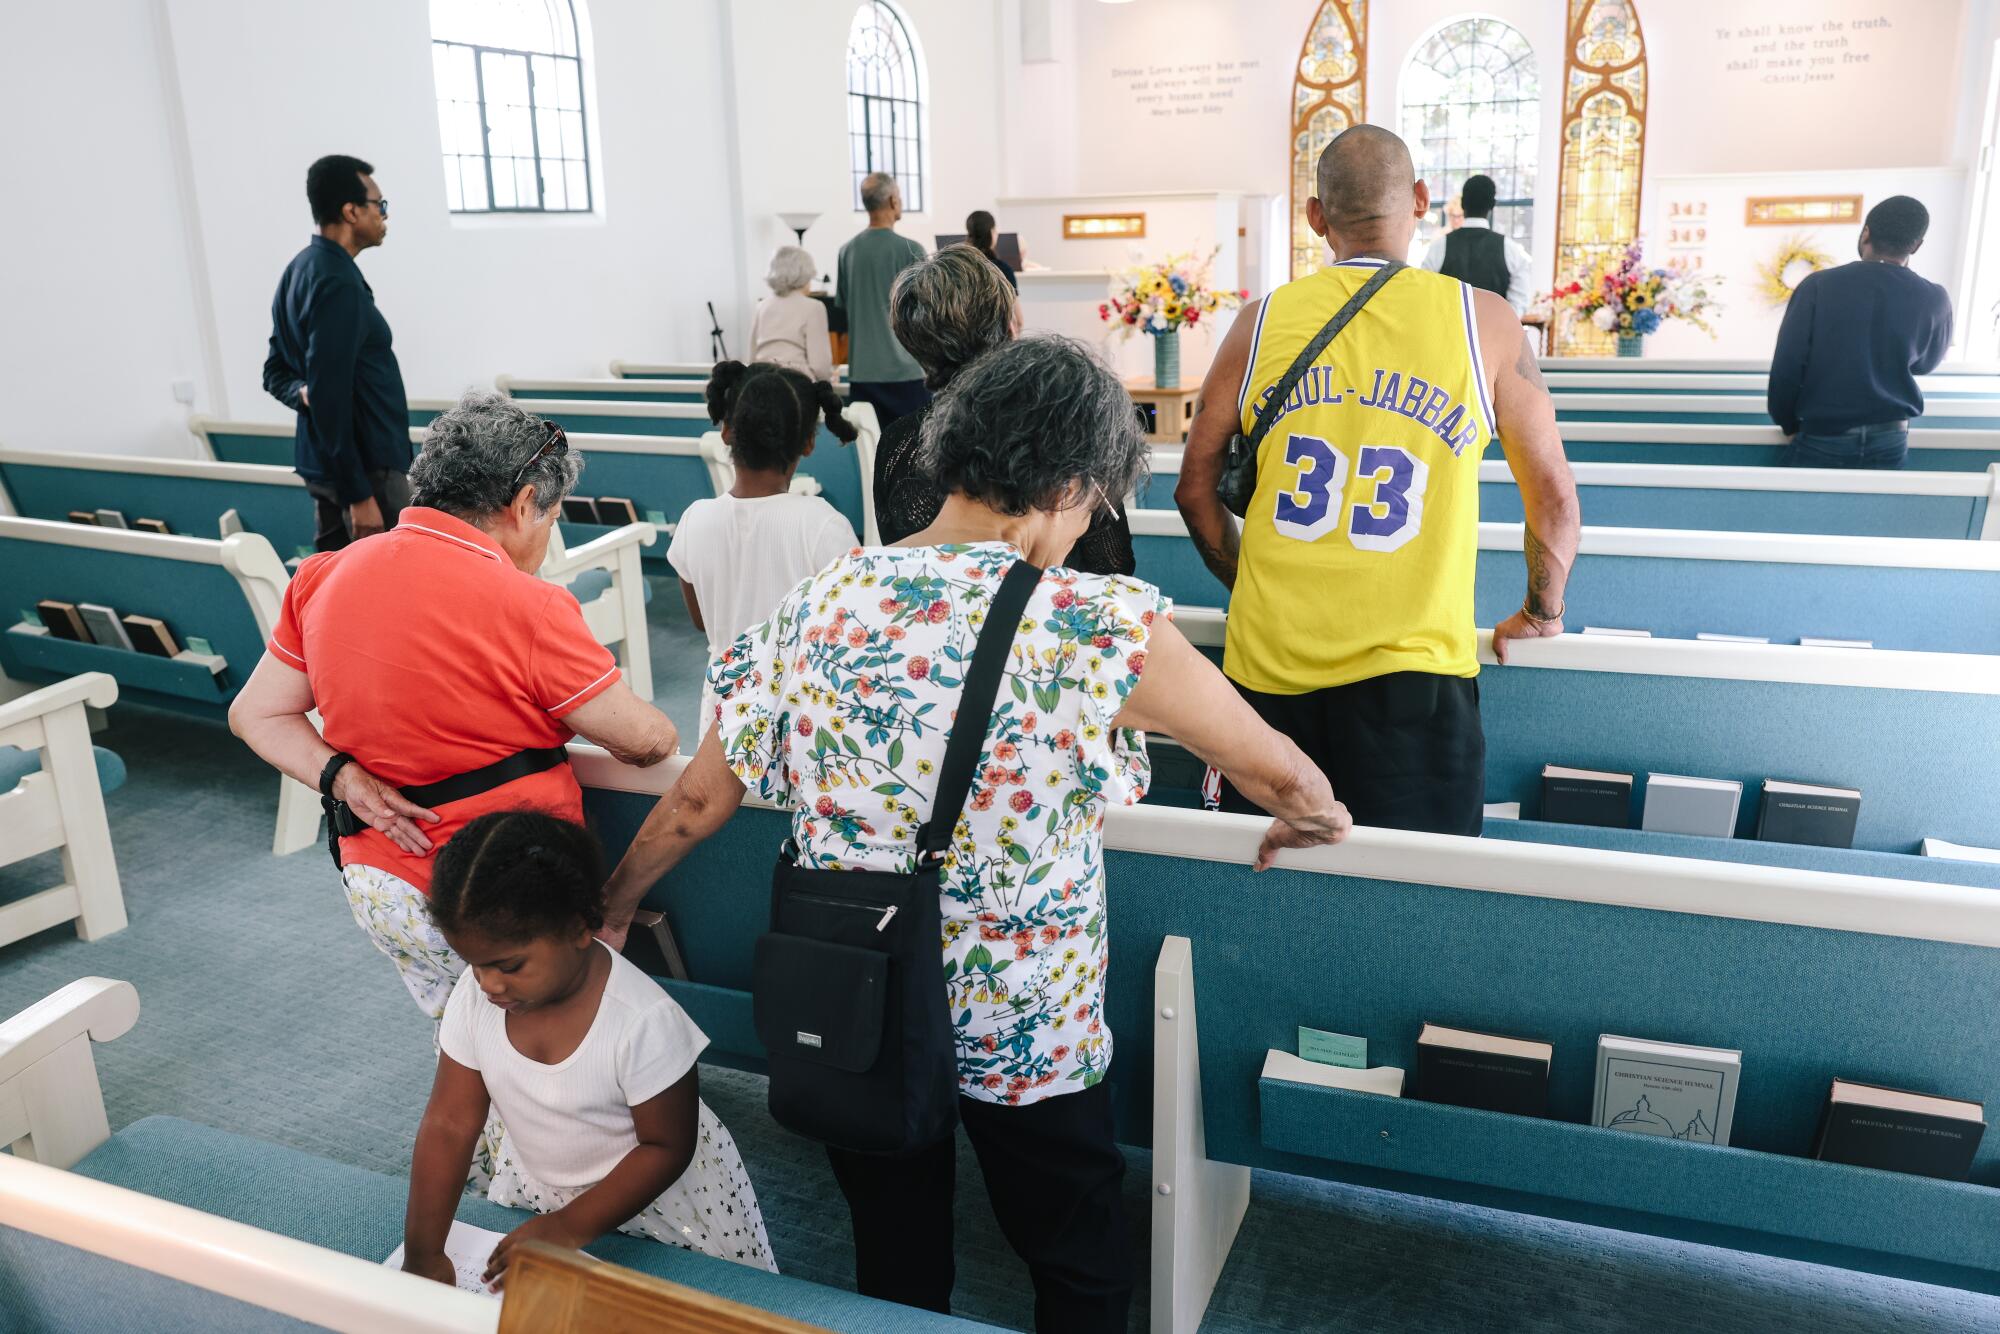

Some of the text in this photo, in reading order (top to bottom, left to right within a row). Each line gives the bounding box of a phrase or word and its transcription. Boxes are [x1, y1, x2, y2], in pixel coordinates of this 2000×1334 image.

[1716, 28, 1731, 40] Ye
[1738, 26, 1771, 38] shall
[1779, 24, 1814, 35] know
[1822, 20, 1844, 32] the
[1753, 37, 1848, 54] and the truth
[1727, 52, 1870, 72] shall make you free
[1804, 72, 1835, 84] Jesus
[1272, 432, 1430, 554] 33
[1614, 1071, 1715, 1090] CHRISTIAN SCIENCE HYMNAL
[1850, 1118, 1894, 1129] CHRISTIAN
[1929, 1128, 1963, 1140] HYMNAL
